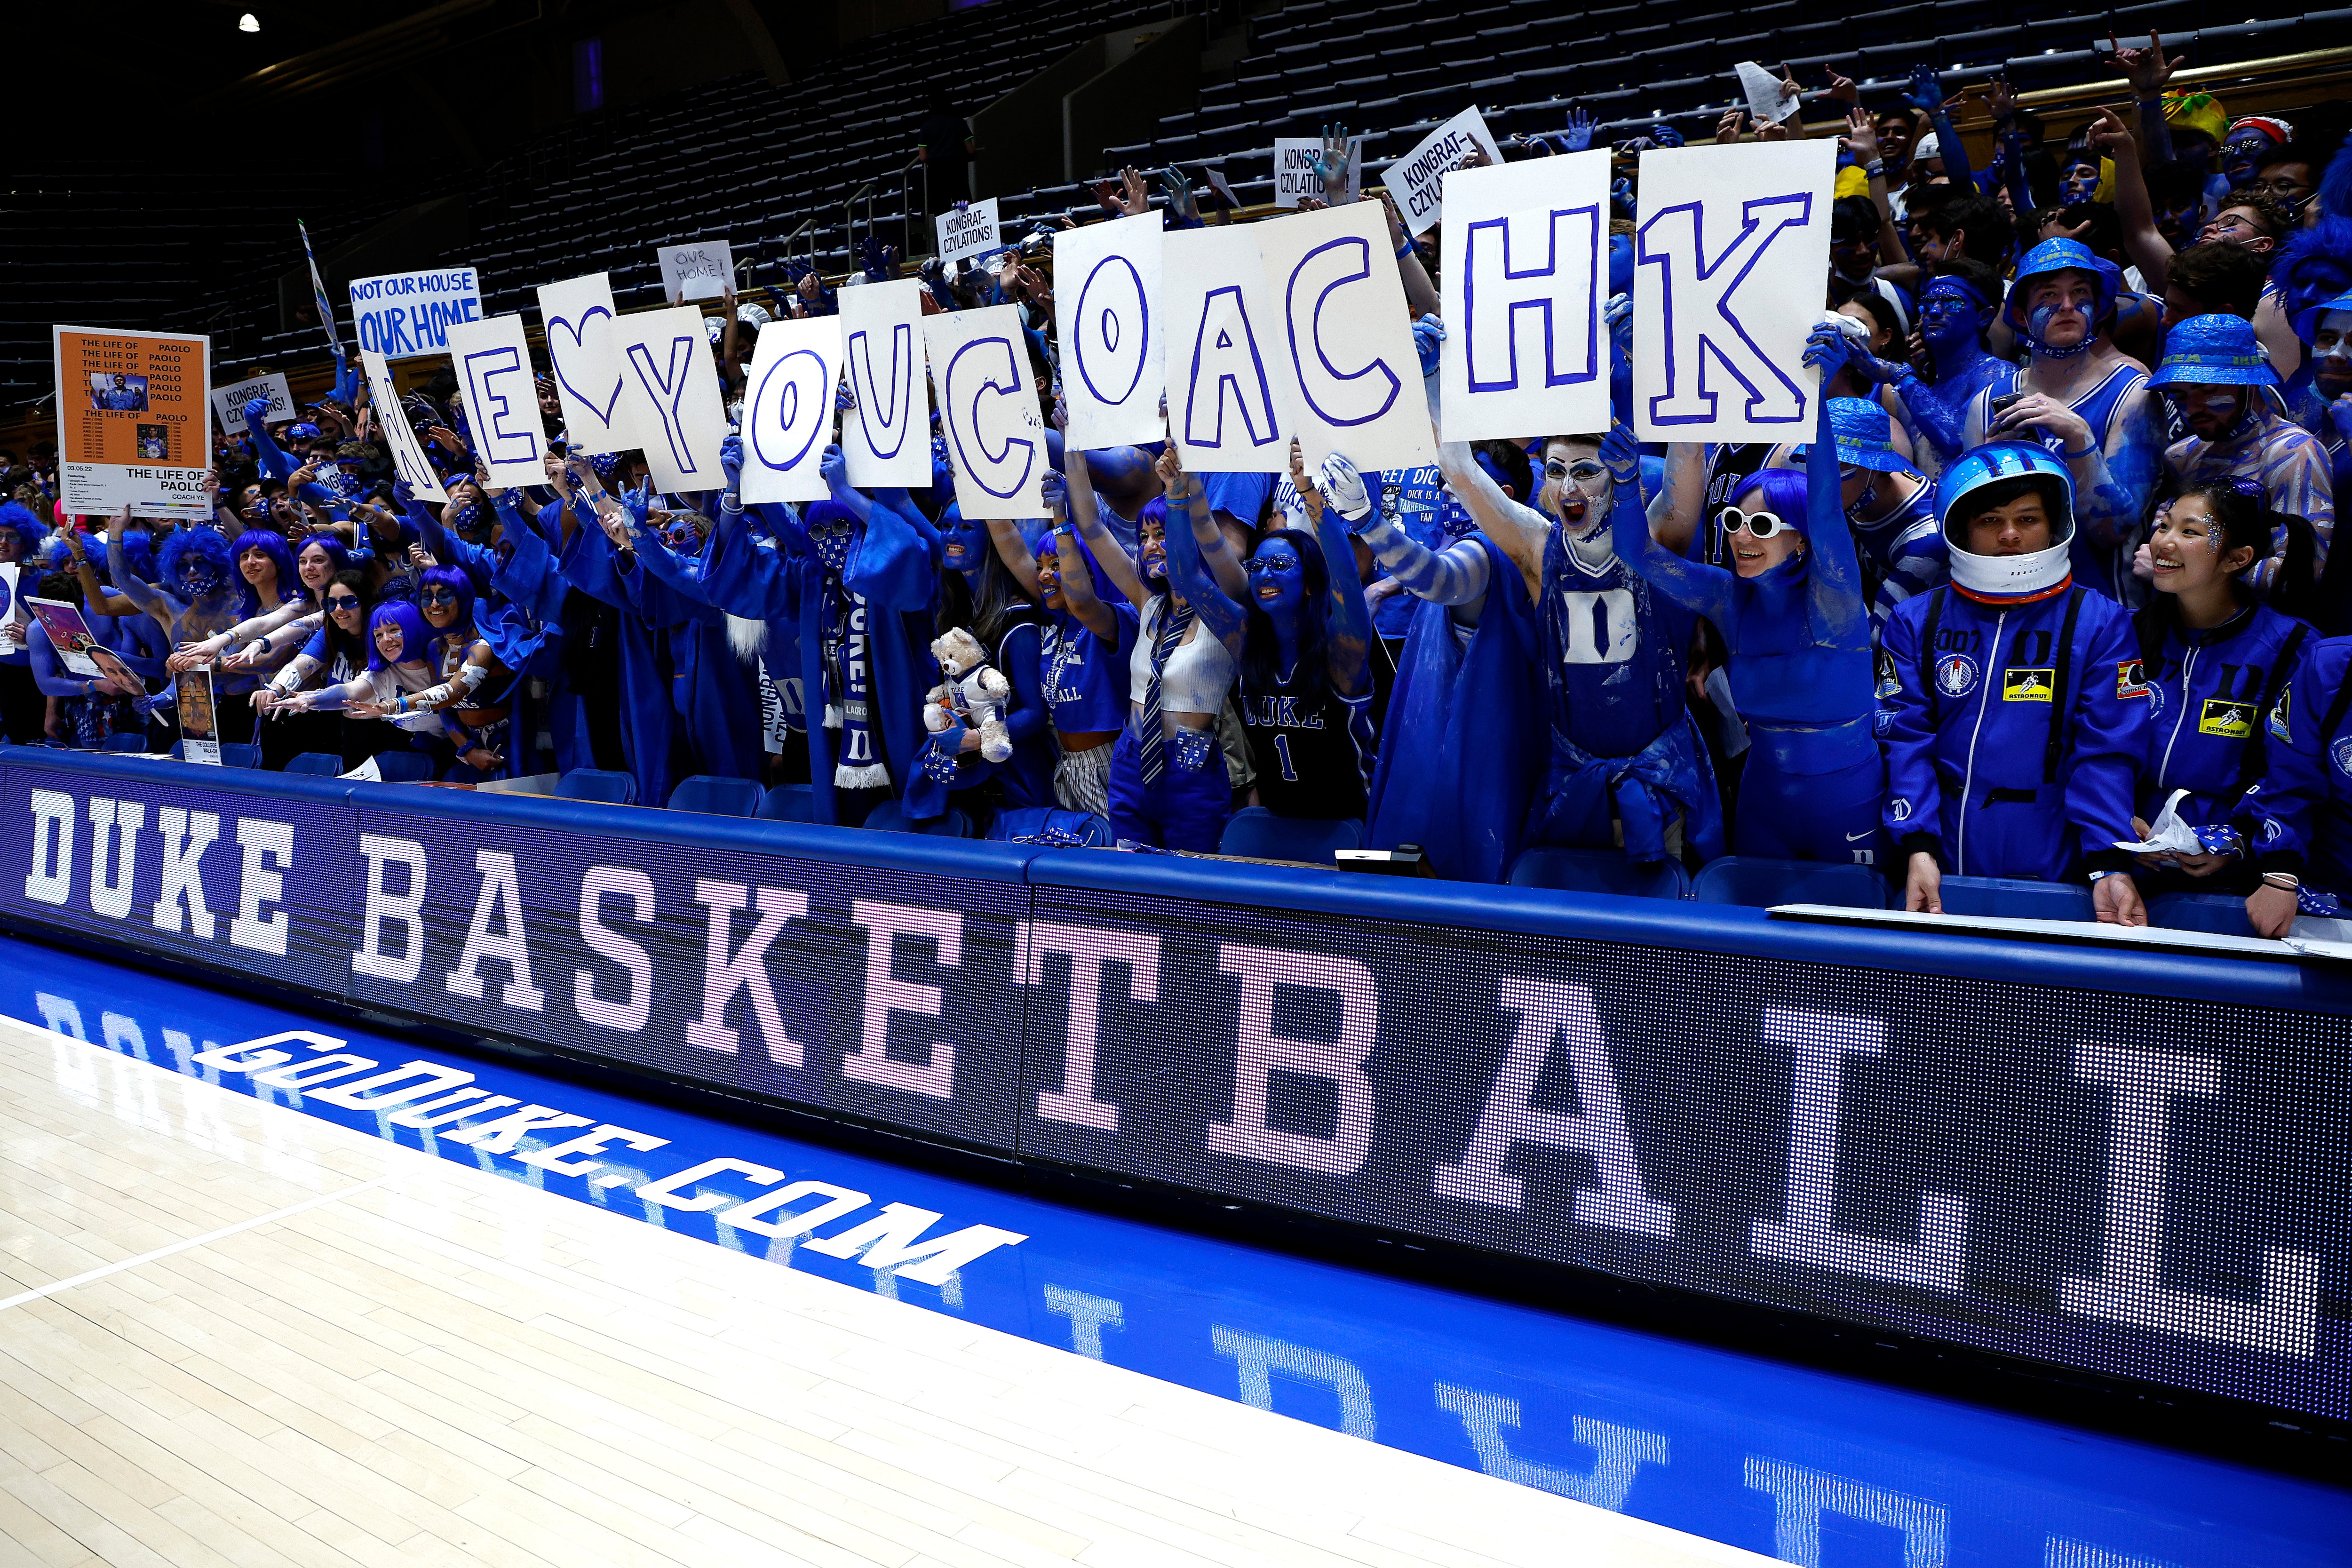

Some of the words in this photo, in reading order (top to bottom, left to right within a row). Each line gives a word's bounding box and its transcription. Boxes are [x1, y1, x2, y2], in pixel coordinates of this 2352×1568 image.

[1402, 131, 1468, 191] KONGRAT-
[946, 209, 986, 235] KONGRAT-
[944, 224, 993, 254] CZYLATIONS!
[674, 250, 713, 264] OUR
[351, 280, 382, 302] NOT
[386, 277, 415, 295] OUR
[419, 272, 473, 293] HOUSE
[1637, 191, 1812, 425] K
[361, 308, 415, 355] OUR
[410, 298, 479, 349] HOME
[126, 468, 151, 479] THE
[156, 470, 183, 480] LIFE
[187, 471, 204, 481] OF
[161, 481, 204, 492] PAOLO
[1412, 469, 1440, 485] DIC
[1399, 498, 1430, 512] TARHEELS
[1407, 489, 1422, 499] DICK
[1426, 491, 1431, 499] IS
[1434, 492, 1440, 501] A
[1420, 512, 1433, 522] FAN
[1937, 629, 1980, 653] 007
[2123, 686, 2142, 695] SUPER
[2206, 726, 2246, 735] ASTRONAUT
[1274, 734, 1298, 781] 1
[24, 788, 294, 956] DUKE
[350, 834, 2319, 1357] BASKETBALL
[191, 1030, 1029, 1287] GODUKE.COM
